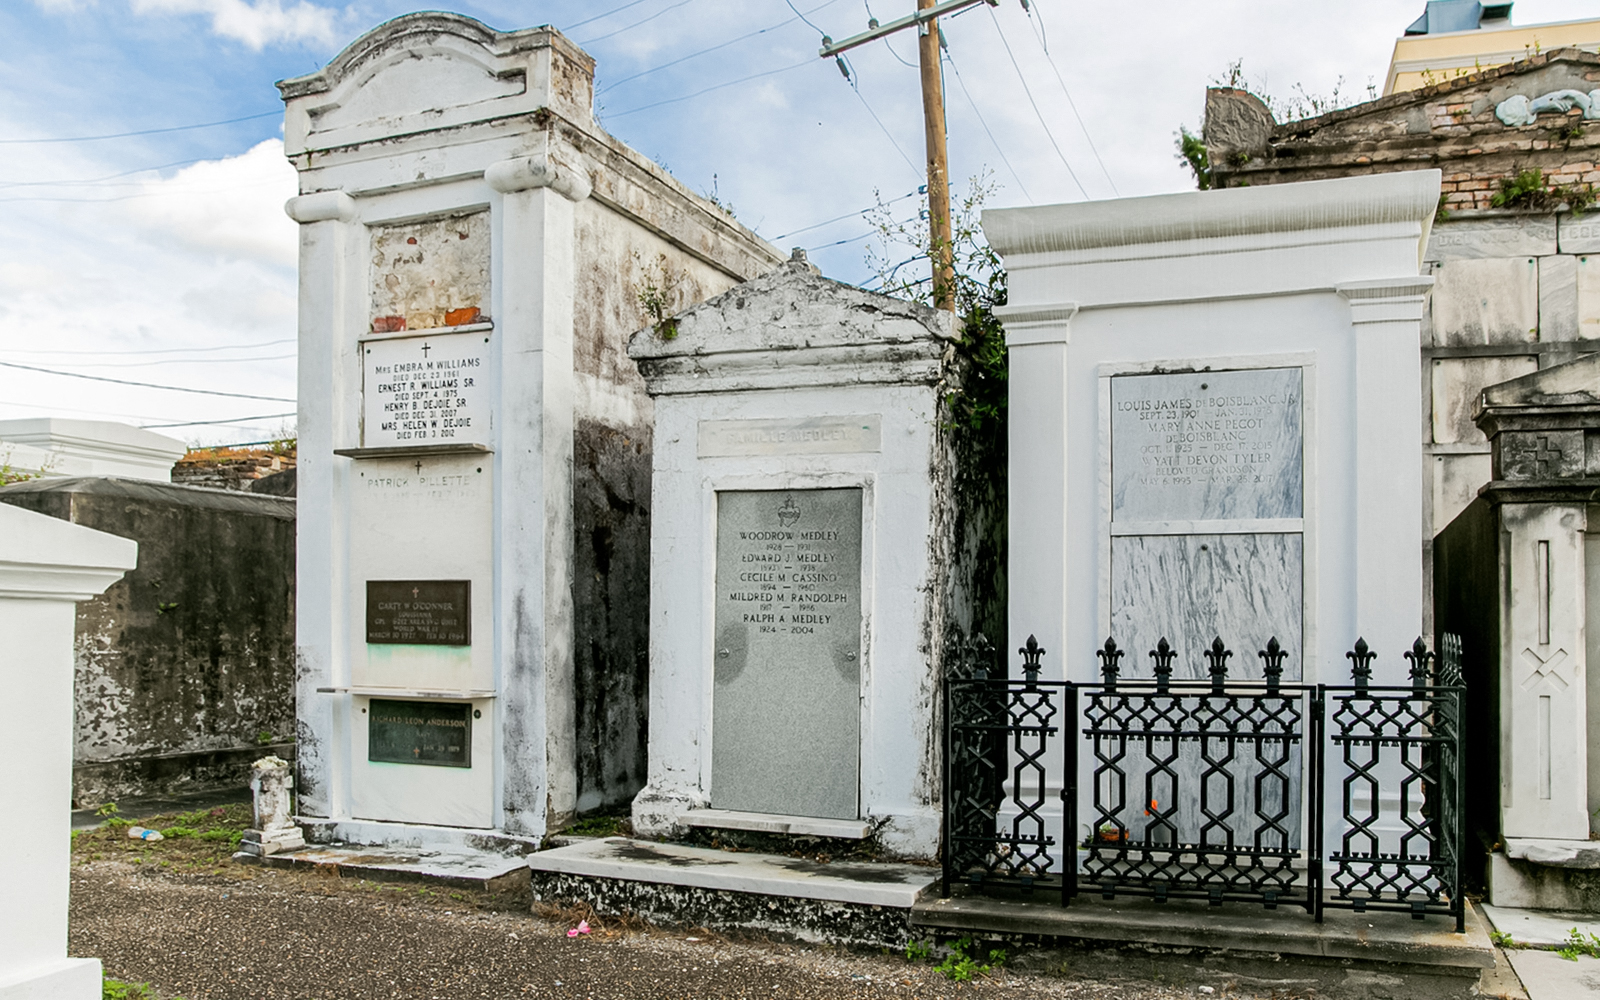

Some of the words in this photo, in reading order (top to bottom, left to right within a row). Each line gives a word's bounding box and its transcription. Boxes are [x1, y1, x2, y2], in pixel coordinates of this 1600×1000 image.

[436, 358, 480, 370] WILLIAMS
[378, 382, 407, 393] ERNEST
[420, 378, 459, 390] WILLIAMS
[395, 393, 409, 402] DIED
[443, 389, 458, 398] 1975
[384, 402, 408, 412] HENRY
[423, 398, 451, 410] DEJOIE
[1117, 400, 1151, 412] LOUIS
[1153, 399, 1192, 411] JAMES
[395, 412, 410, 421] DIED
[441, 409, 457, 418] 2007
[402, 420, 427, 430] HELEN
[443, 417, 472, 428] DEJOIE
[1148, 421, 1181, 433] MARY
[1186, 419, 1221, 431] ANNE
[1225, 418, 1264, 430] PECOT
[396, 431, 412, 440] DIED
[440, 429, 455, 438] 2012
[1251, 441, 1272, 451] 2015
[1142, 455, 1182, 467] WYATT
[1187, 453, 1228, 466] DEVON
[1233, 452, 1271, 464] TYLER
[1155, 466, 1198, 476] BELOVED
[1201, 464, 1257, 475] GRANDSON
[367, 478, 409, 488] PATRICK
[1140, 477, 1160, 486] MAY
[1172, 476, 1192, 485] 1995
[740, 531, 794, 541] WOODROW
[801, 531, 840, 541] MEDLEY
[797, 543, 811, 551] 1931
[742, 553, 781, 563] EDWARD
[797, 553, 836, 563] MEDLEY
[740, 572, 774, 582] CECILE
[792, 572, 837, 583] CASSINO
[729, 592, 773, 602] MILDRED
[791, 593, 847, 603] RANDOLPH
[743, 613, 775, 623] RALPH
[792, 614, 831, 624] MEDLEY
[759, 625, 776, 633] 1924
[791, 626, 814, 634] 2004
[371, 715, 401, 724] RICHARD
[405, 717, 424, 725] LEON
[426, 718, 466, 728] ANDERSON
